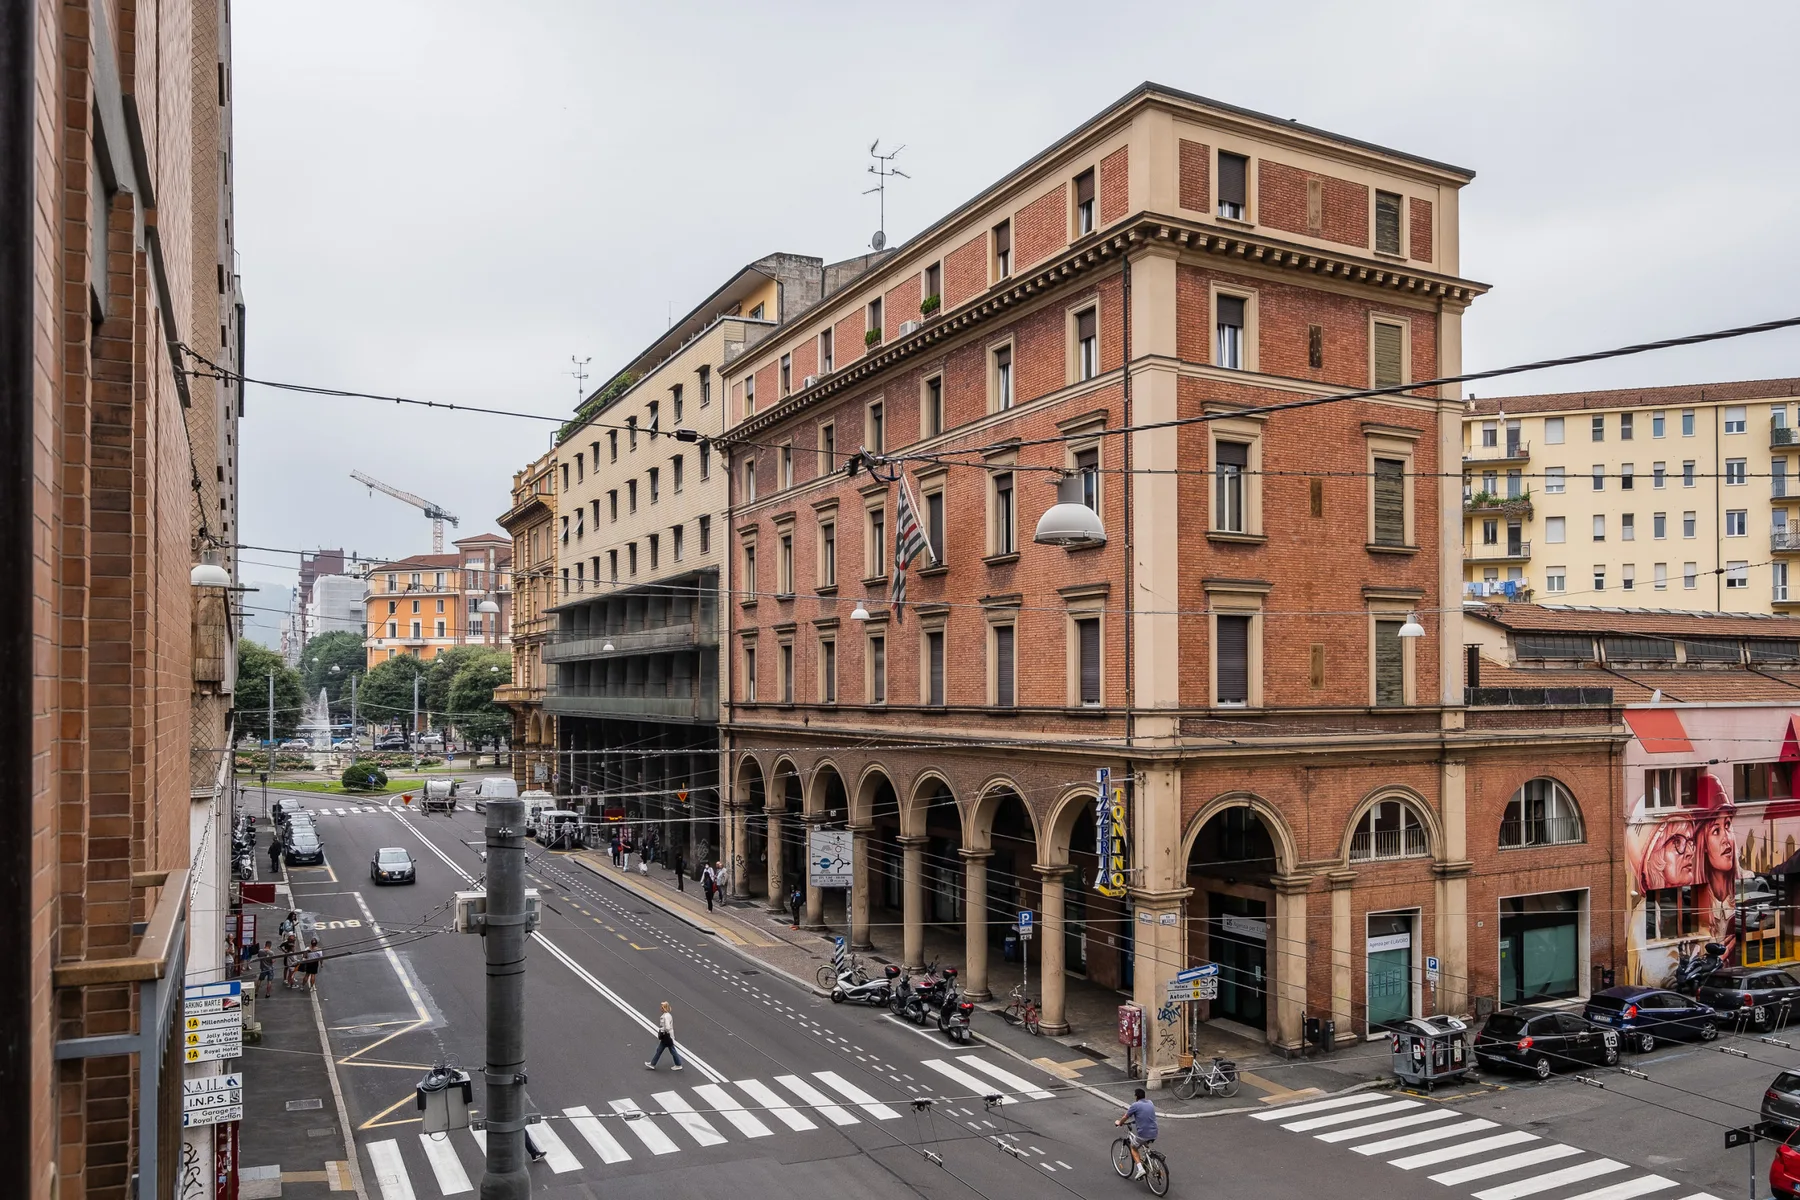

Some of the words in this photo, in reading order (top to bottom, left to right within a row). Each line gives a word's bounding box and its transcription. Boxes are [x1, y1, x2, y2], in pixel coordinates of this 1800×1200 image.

[1098, 768, 1110, 885] PIZZERIA
[1111, 788, 1125, 888] TONINO
[313, 919, 362, 930] BUS
[1021, 913, 1030, 925] P
[185, 1000, 203, 1009] ARKING
[201, 1016, 240, 1026] Millennhotel
[1605, 1036, 1617, 1046] 15
[188, 1051, 199, 1059] 1A
[189, 1094, 227, 1107] I.N.P.S.
[201, 1107, 229, 1116] Garage
[193, 1115, 213, 1125] Royal
[215, 1112, 241, 1121] Carlton
